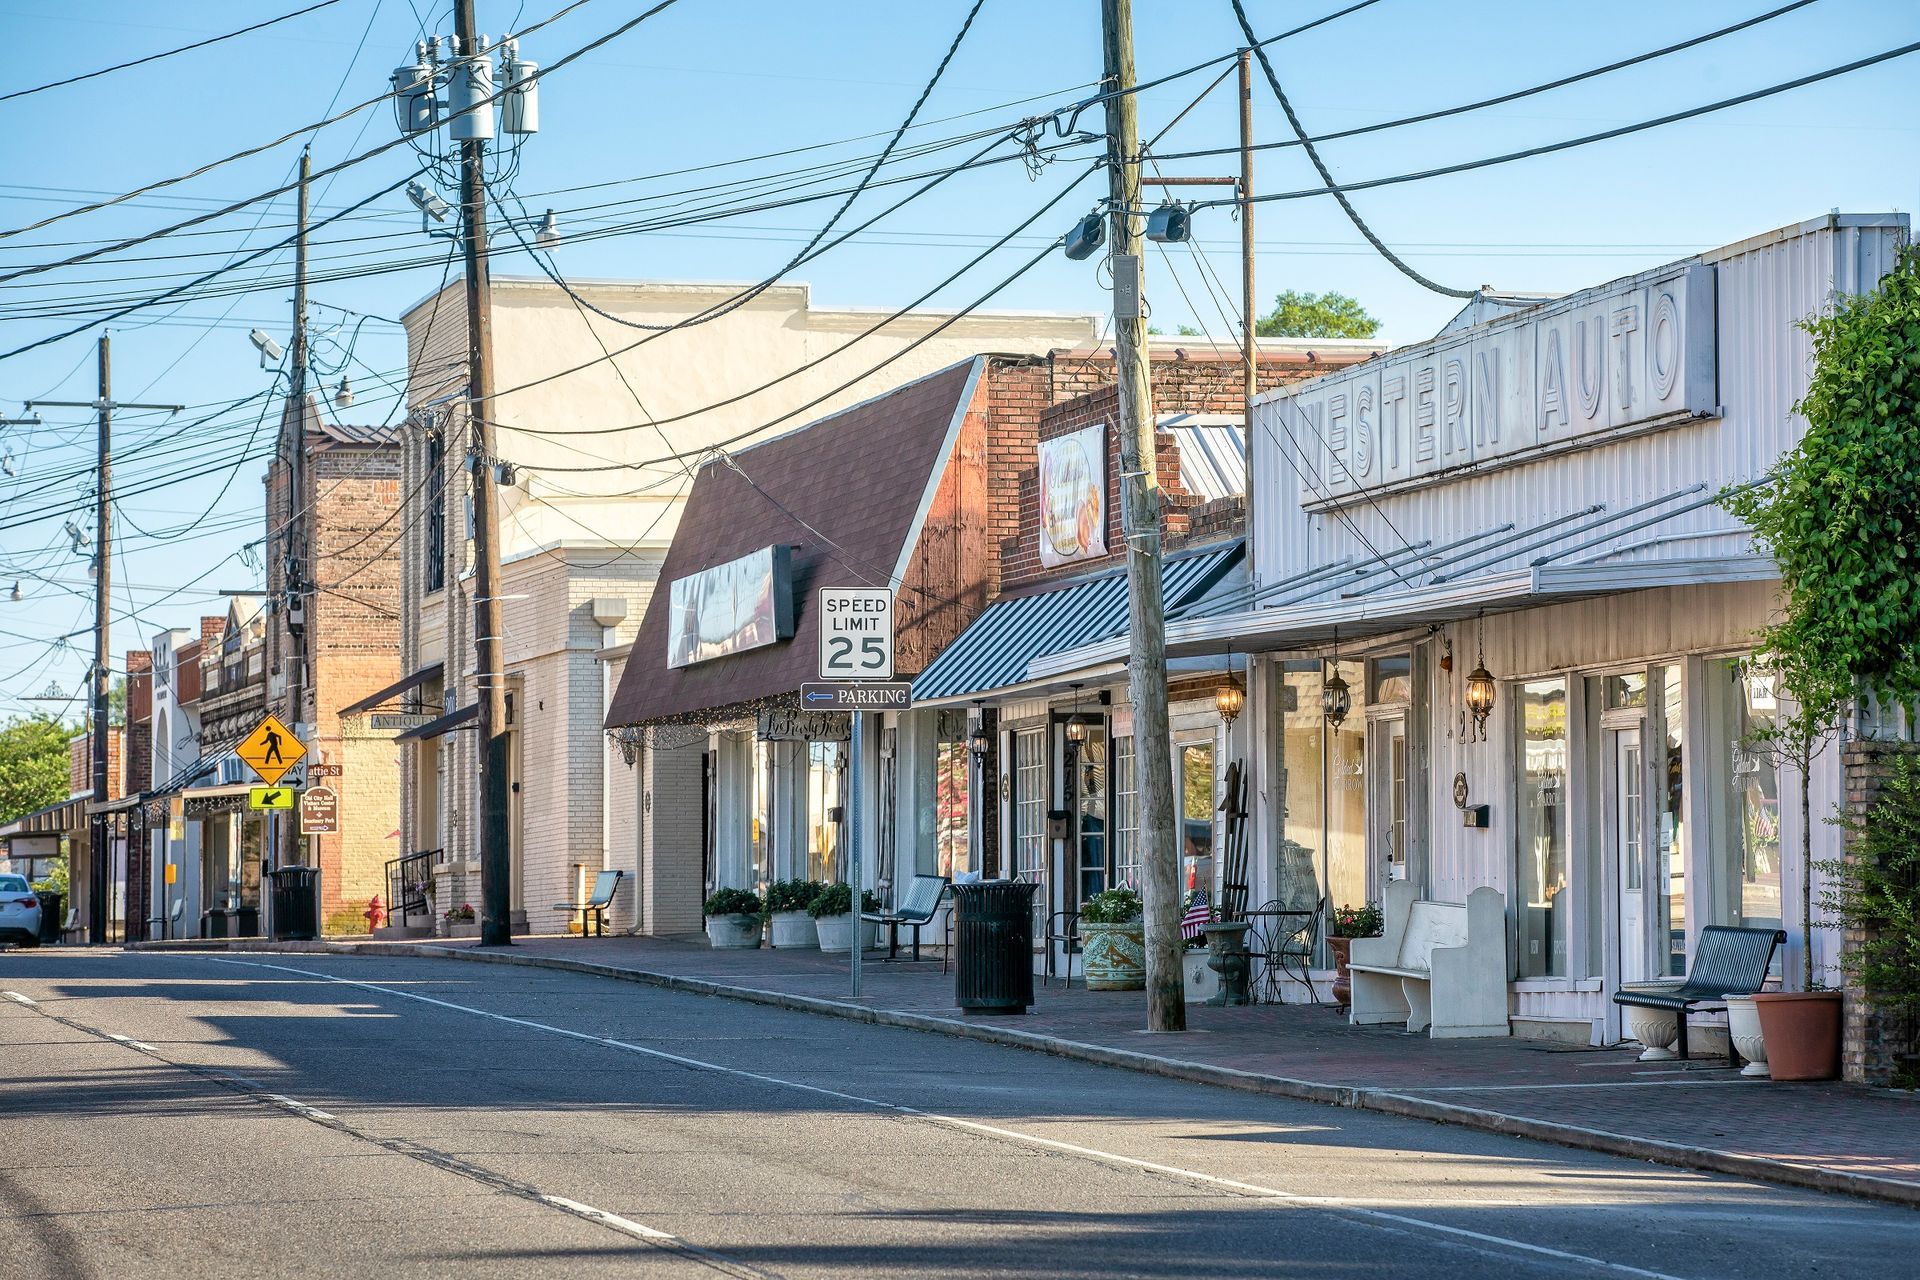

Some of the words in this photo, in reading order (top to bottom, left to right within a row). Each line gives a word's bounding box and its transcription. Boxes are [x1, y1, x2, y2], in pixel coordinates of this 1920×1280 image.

[1300, 347, 1500, 492] WESTERN
[1540, 293, 1680, 431] AUTO
[827, 599, 886, 612] SPEED
[833, 618, 879, 631] LIMIT
[828, 636, 886, 669] 25
[837, 690, 907, 703] PARKING
[288, 766, 304, 775] AY
[308, 766, 329, 776] attie
[330, 766, 340, 776] St
